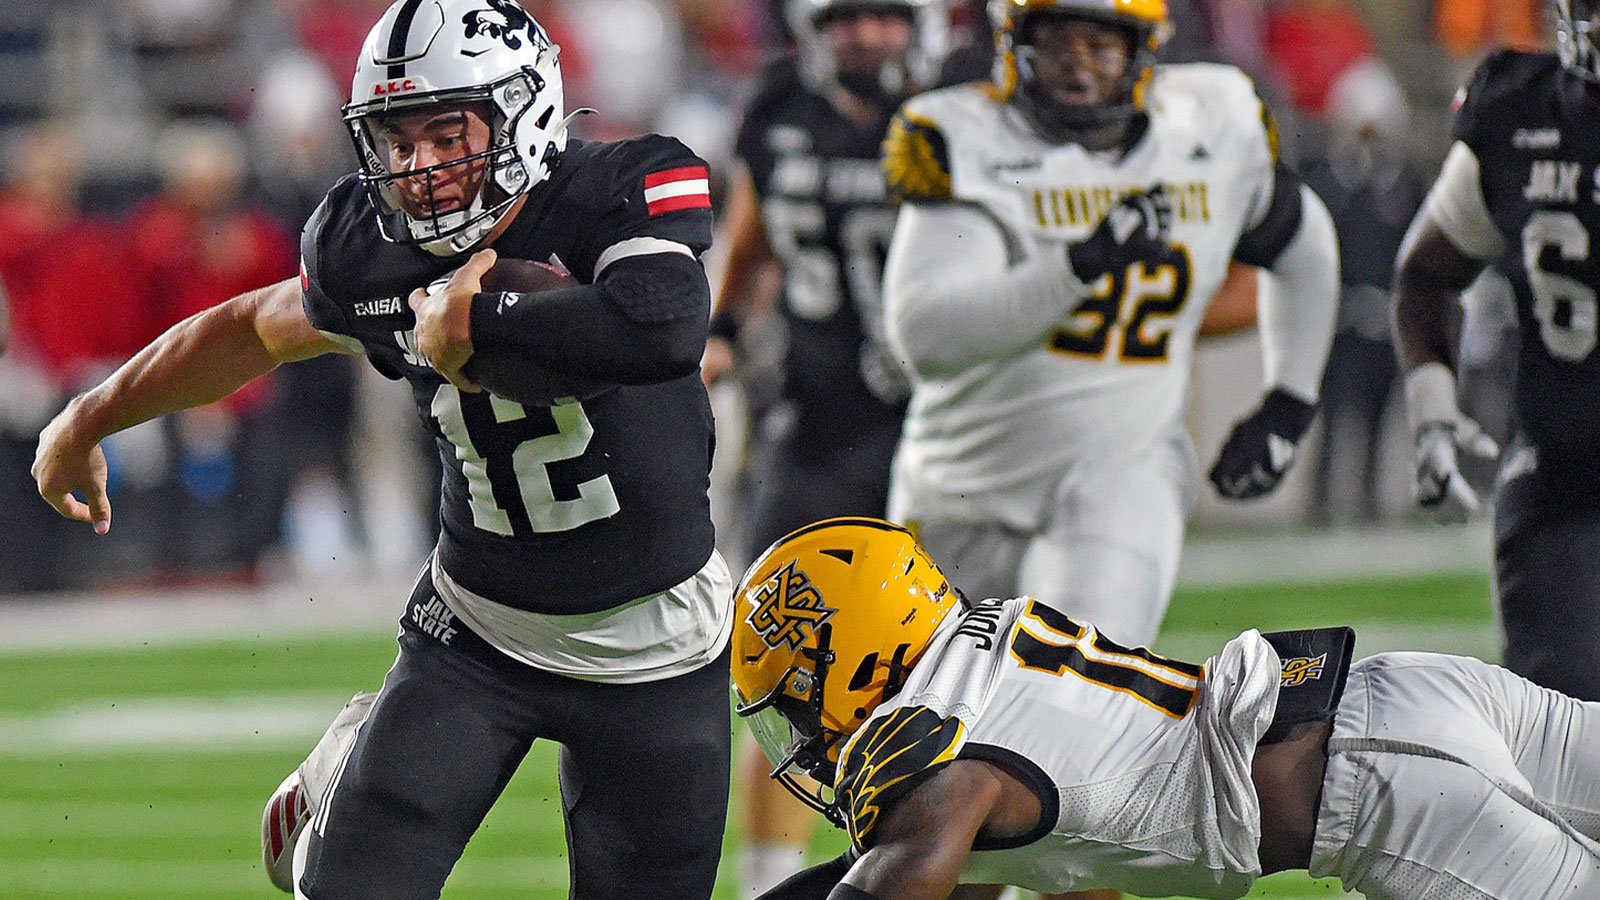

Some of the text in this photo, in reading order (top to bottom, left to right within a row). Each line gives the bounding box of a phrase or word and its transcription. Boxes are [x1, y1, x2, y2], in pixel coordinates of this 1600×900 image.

[366, 151, 394, 190] Riddll
[1523, 211, 1599, 362] 6
[431, 383, 621, 537] 12
[412, 603, 458, 646] STATE
[422, 595, 455, 626] JAX
